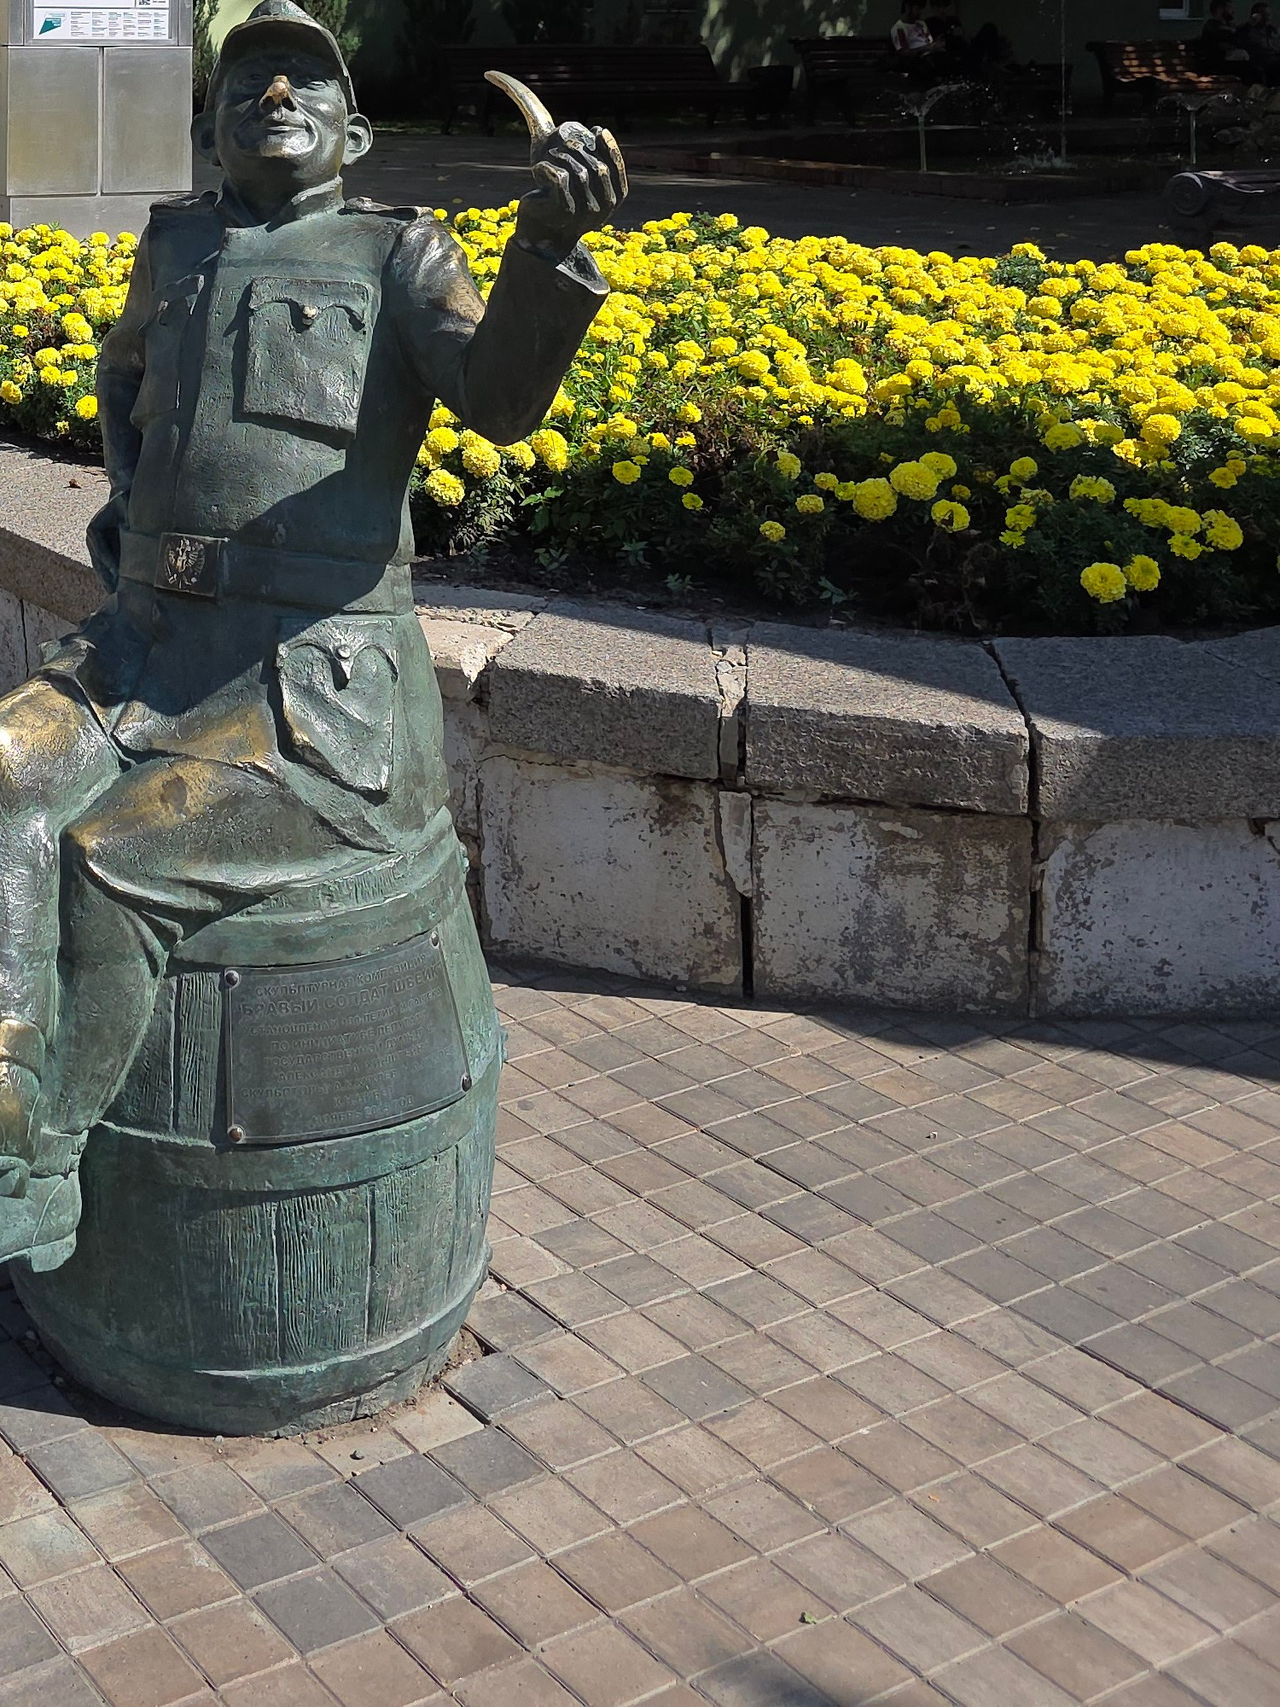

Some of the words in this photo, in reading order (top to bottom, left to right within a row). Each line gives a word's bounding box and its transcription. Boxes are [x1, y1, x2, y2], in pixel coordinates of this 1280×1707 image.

[255, 974, 354, 998] СКУЛЬПТУРНАЯ
[323, 982, 390, 1012] СОЛДАТ
[270, 1040, 290, 1052] ПО
